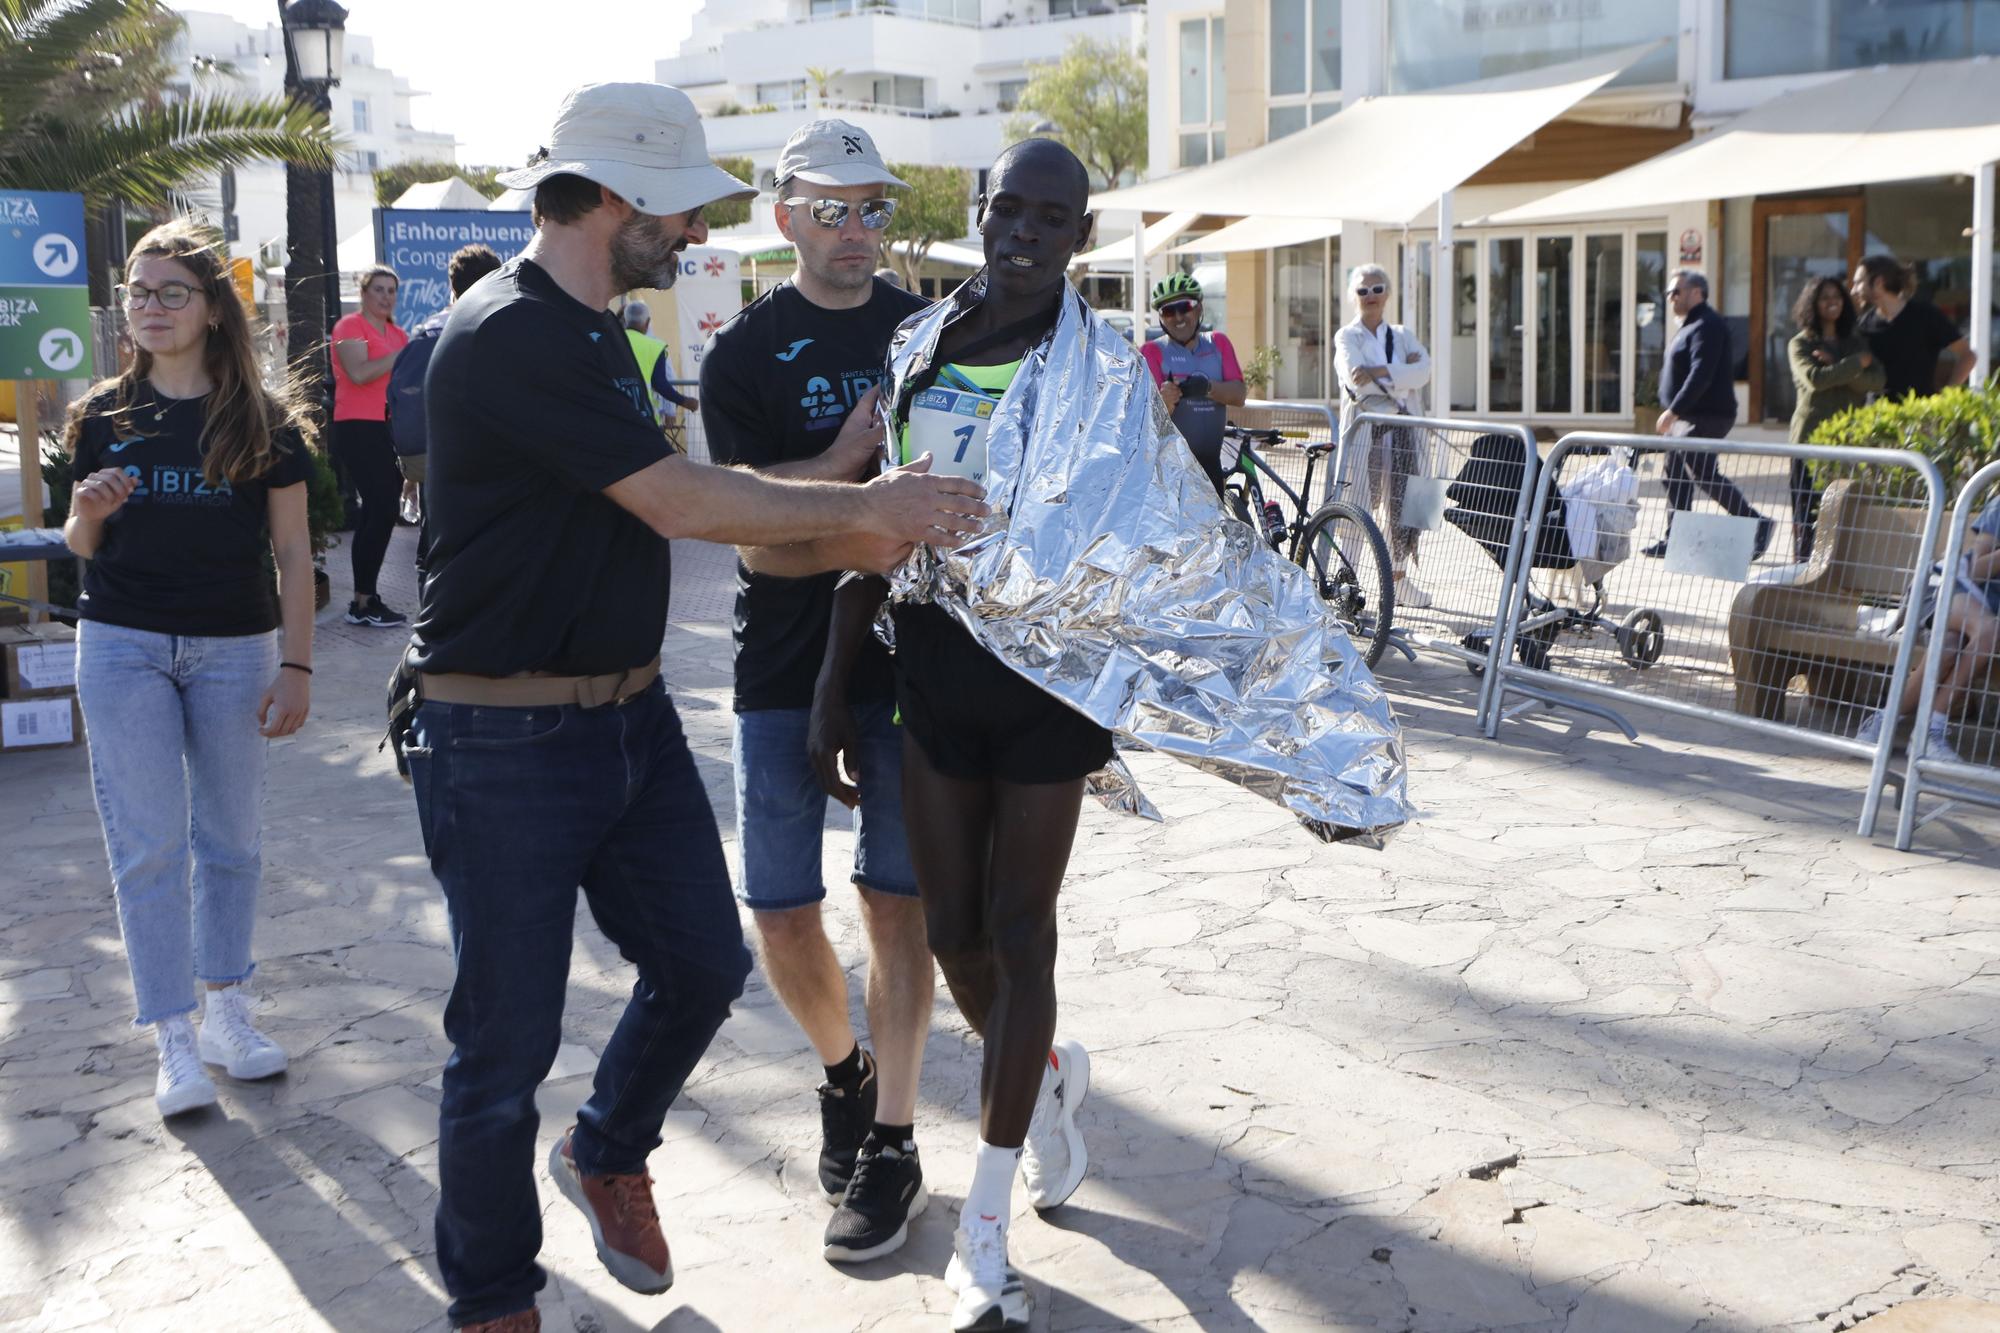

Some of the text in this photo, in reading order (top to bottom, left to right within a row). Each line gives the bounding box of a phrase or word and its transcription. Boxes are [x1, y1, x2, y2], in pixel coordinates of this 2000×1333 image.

[0, 199, 39, 218] IZA
[840, 370, 864, 379] SANTA
[926, 393, 948, 405] IBIZA
[953, 424, 977, 463] 1
[153, 470, 233, 496] IBIZA
